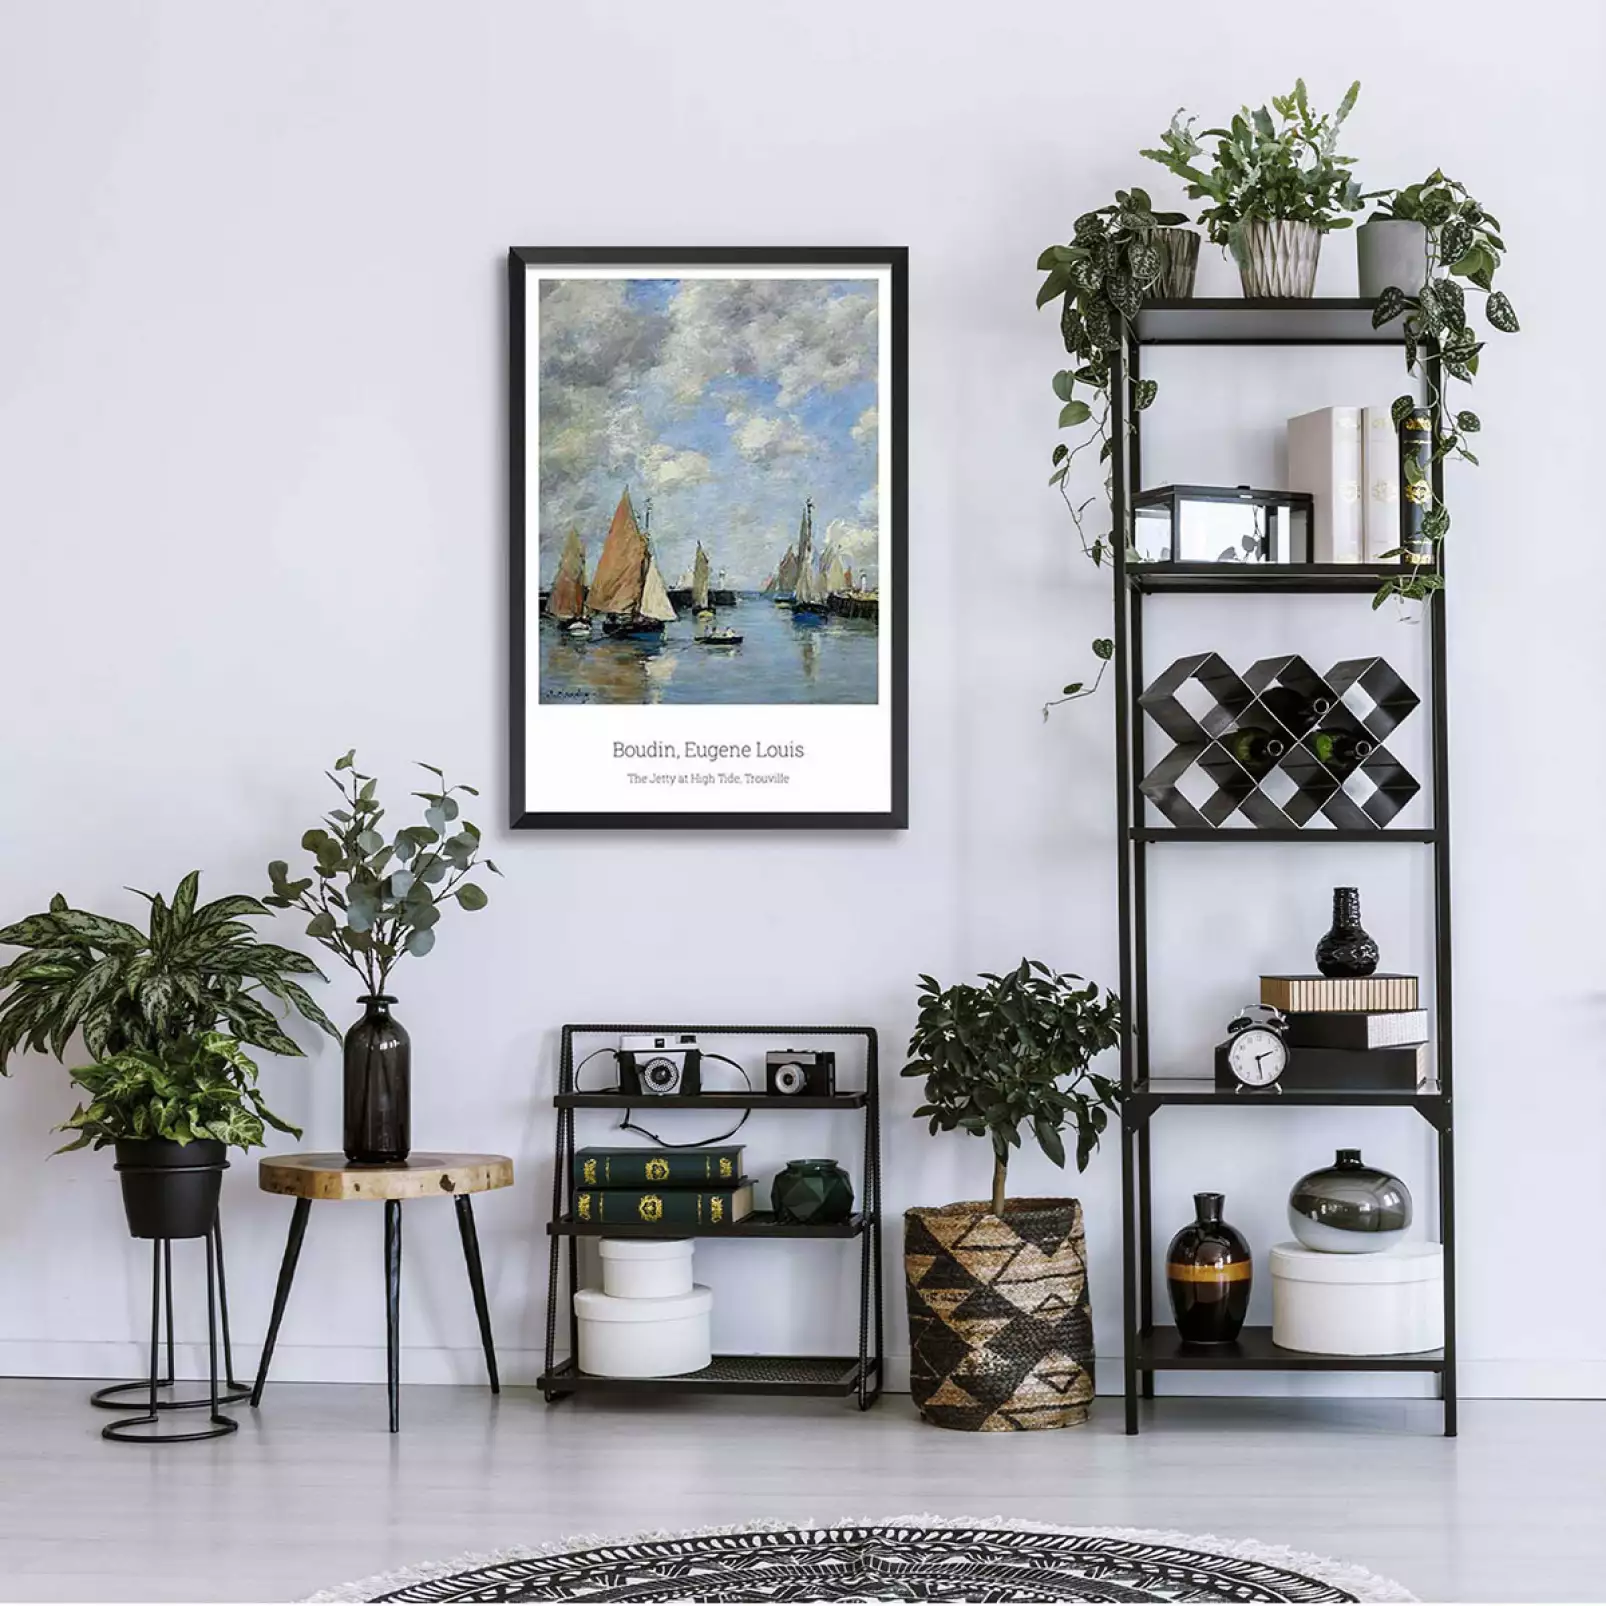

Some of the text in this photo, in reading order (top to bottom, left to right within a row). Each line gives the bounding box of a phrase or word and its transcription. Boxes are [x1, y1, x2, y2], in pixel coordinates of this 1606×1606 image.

[612, 740, 805, 762] Boudin, Eugene Louis
[627, 773, 790, 786] The Jetty at High Tide, Trouville
